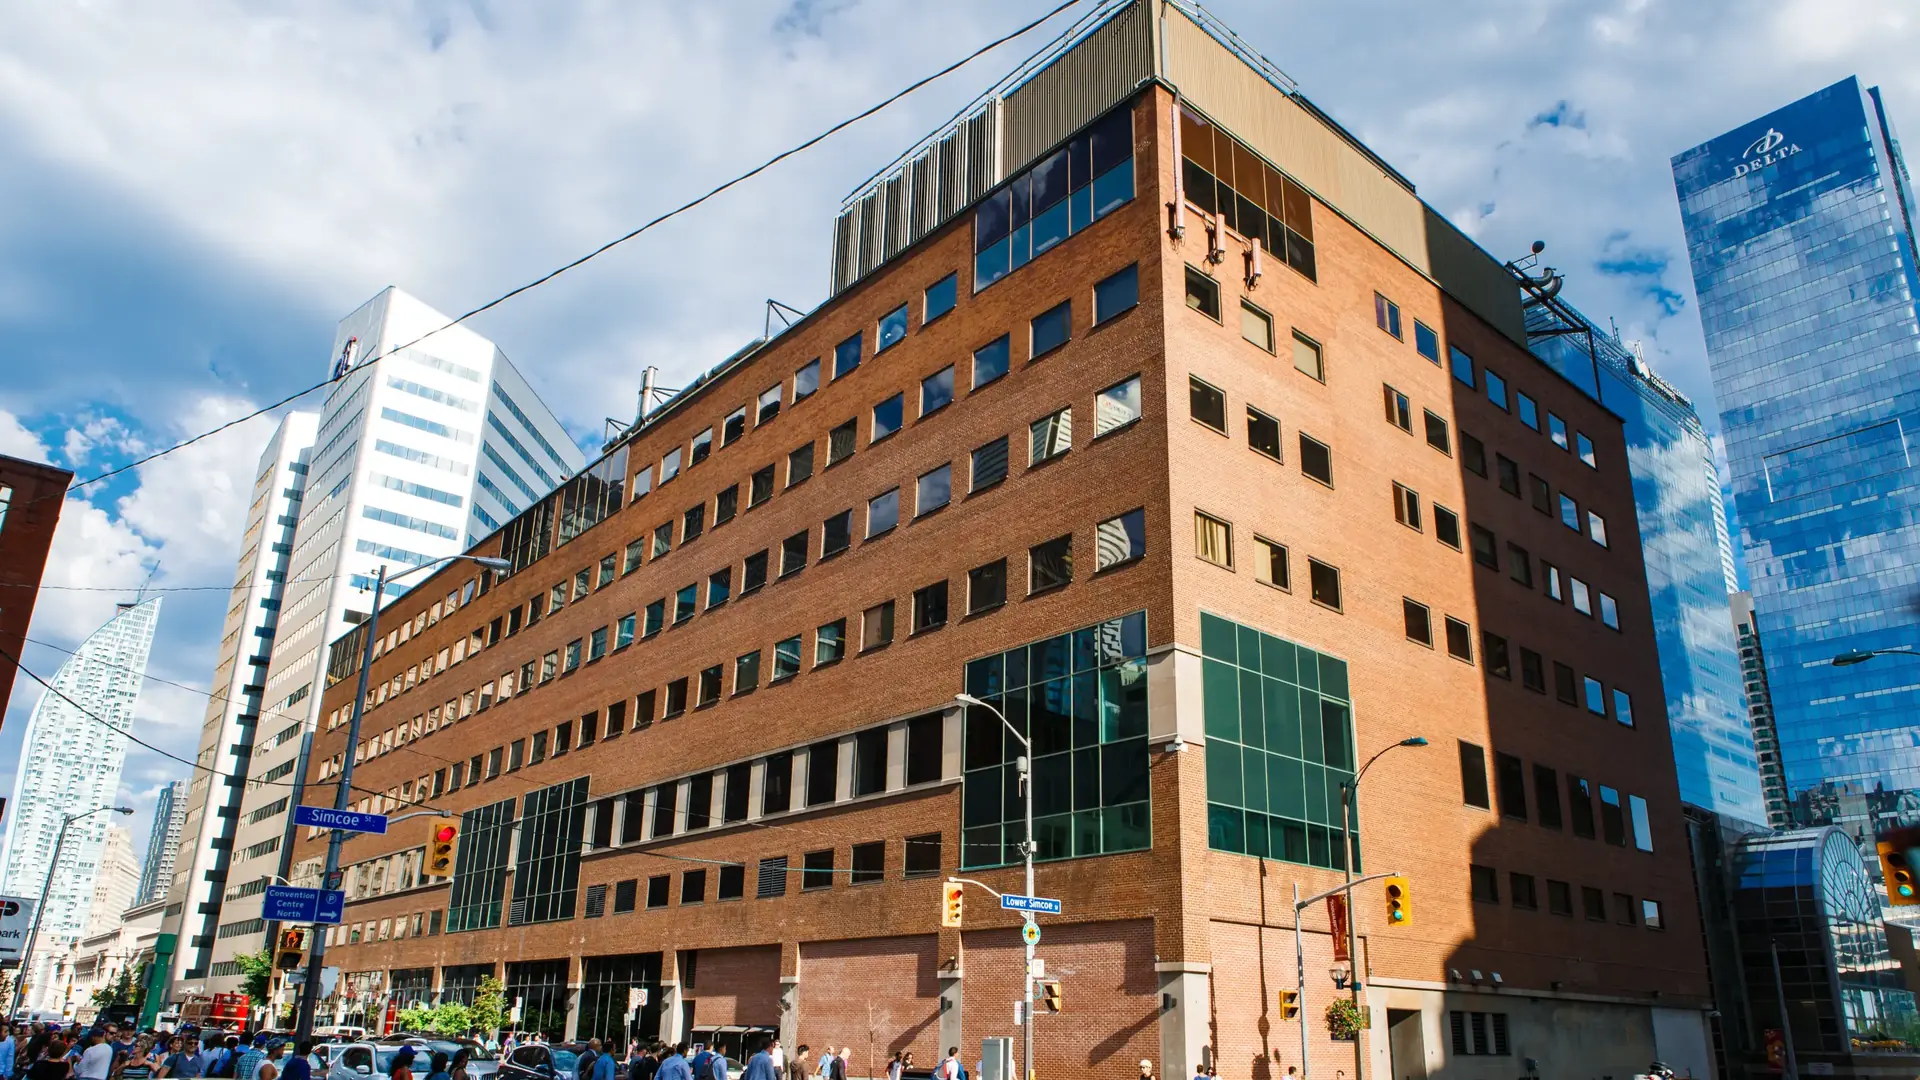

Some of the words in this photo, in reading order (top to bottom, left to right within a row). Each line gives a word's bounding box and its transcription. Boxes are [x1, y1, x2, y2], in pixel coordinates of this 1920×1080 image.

[1734, 144, 1802, 179] DELTA
[311, 809, 360, 826] Simcoe
[269, 889, 315, 899] Convention
[276, 900, 304, 908] Centre
[1006, 896, 1026, 907] Lower
[1029, 899, 1053, 909] Simcoe
[0, 929, 20, 939] ark
